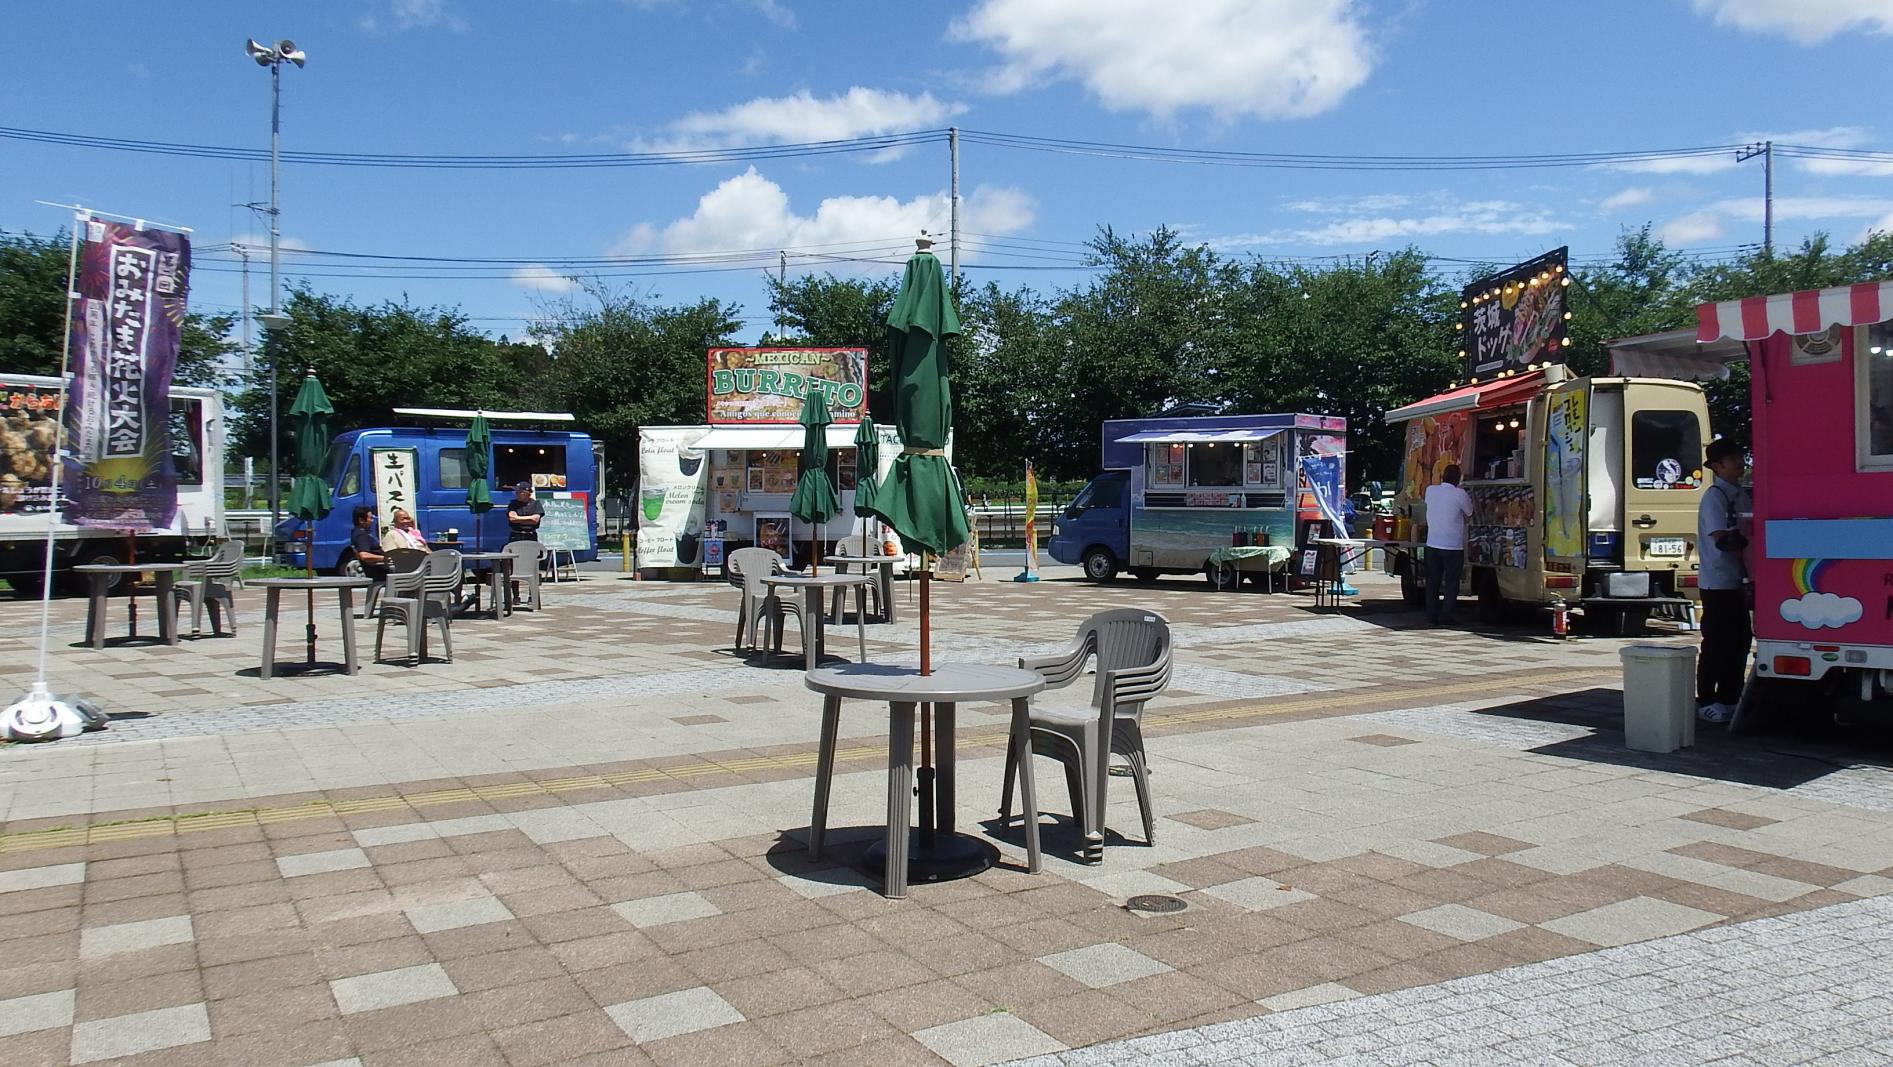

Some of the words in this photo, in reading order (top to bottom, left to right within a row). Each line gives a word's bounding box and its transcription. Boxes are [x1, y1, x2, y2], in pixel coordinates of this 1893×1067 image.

[1474, 300, 1500, 335] 茨城
[110, 253, 147, 452] おみたま花火大会
[713, 368, 864, 408] BURRITO
